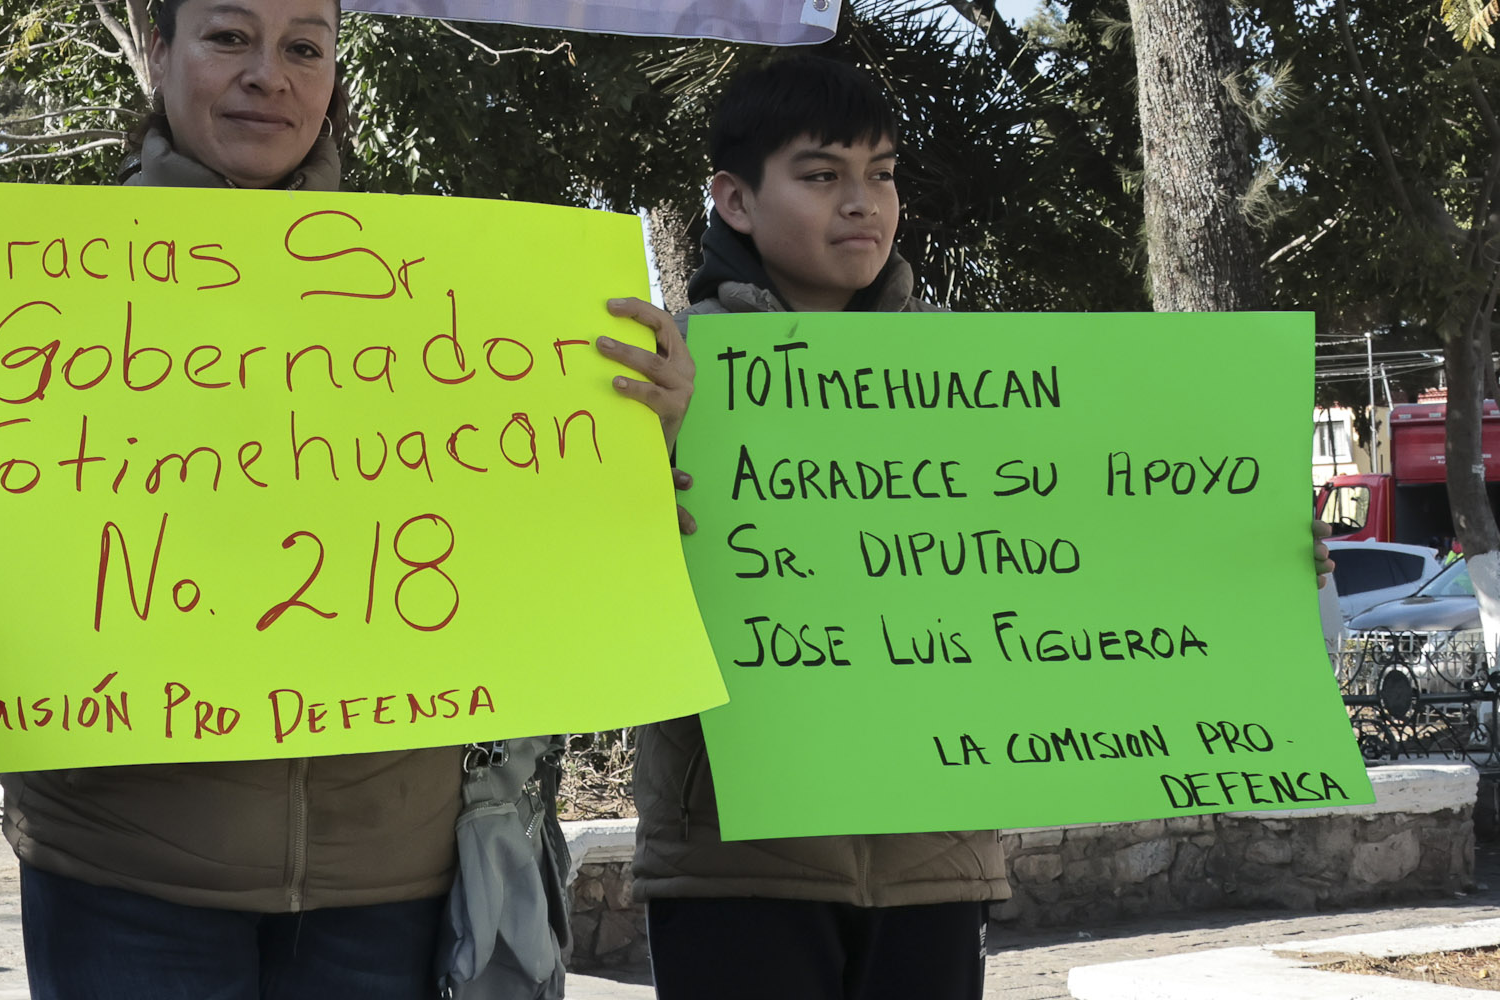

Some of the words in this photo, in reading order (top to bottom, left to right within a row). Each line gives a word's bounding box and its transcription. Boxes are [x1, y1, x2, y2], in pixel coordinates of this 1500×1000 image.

[718, 342, 1060, 410] TOTIMEHUACAN
[732, 445, 967, 500] AGRADECE
[994, 460, 1057, 496] SU
[1108, 452, 1259, 496] APOYO
[96, 514, 215, 632] No.
[256, 514, 459, 631] 218
[860, 530, 1079, 577] DIPUTADO
[734, 616, 851, 667] JOSE
[993, 611, 1207, 662] FIGUEROA
[164, 682, 240, 739] PRO
[268, 686, 494, 743] DEFENSA
[933, 734, 990, 765] LA
[1007, 725, 1169, 763] COMISION
[1160, 772, 1349, 808] DEFENSA
